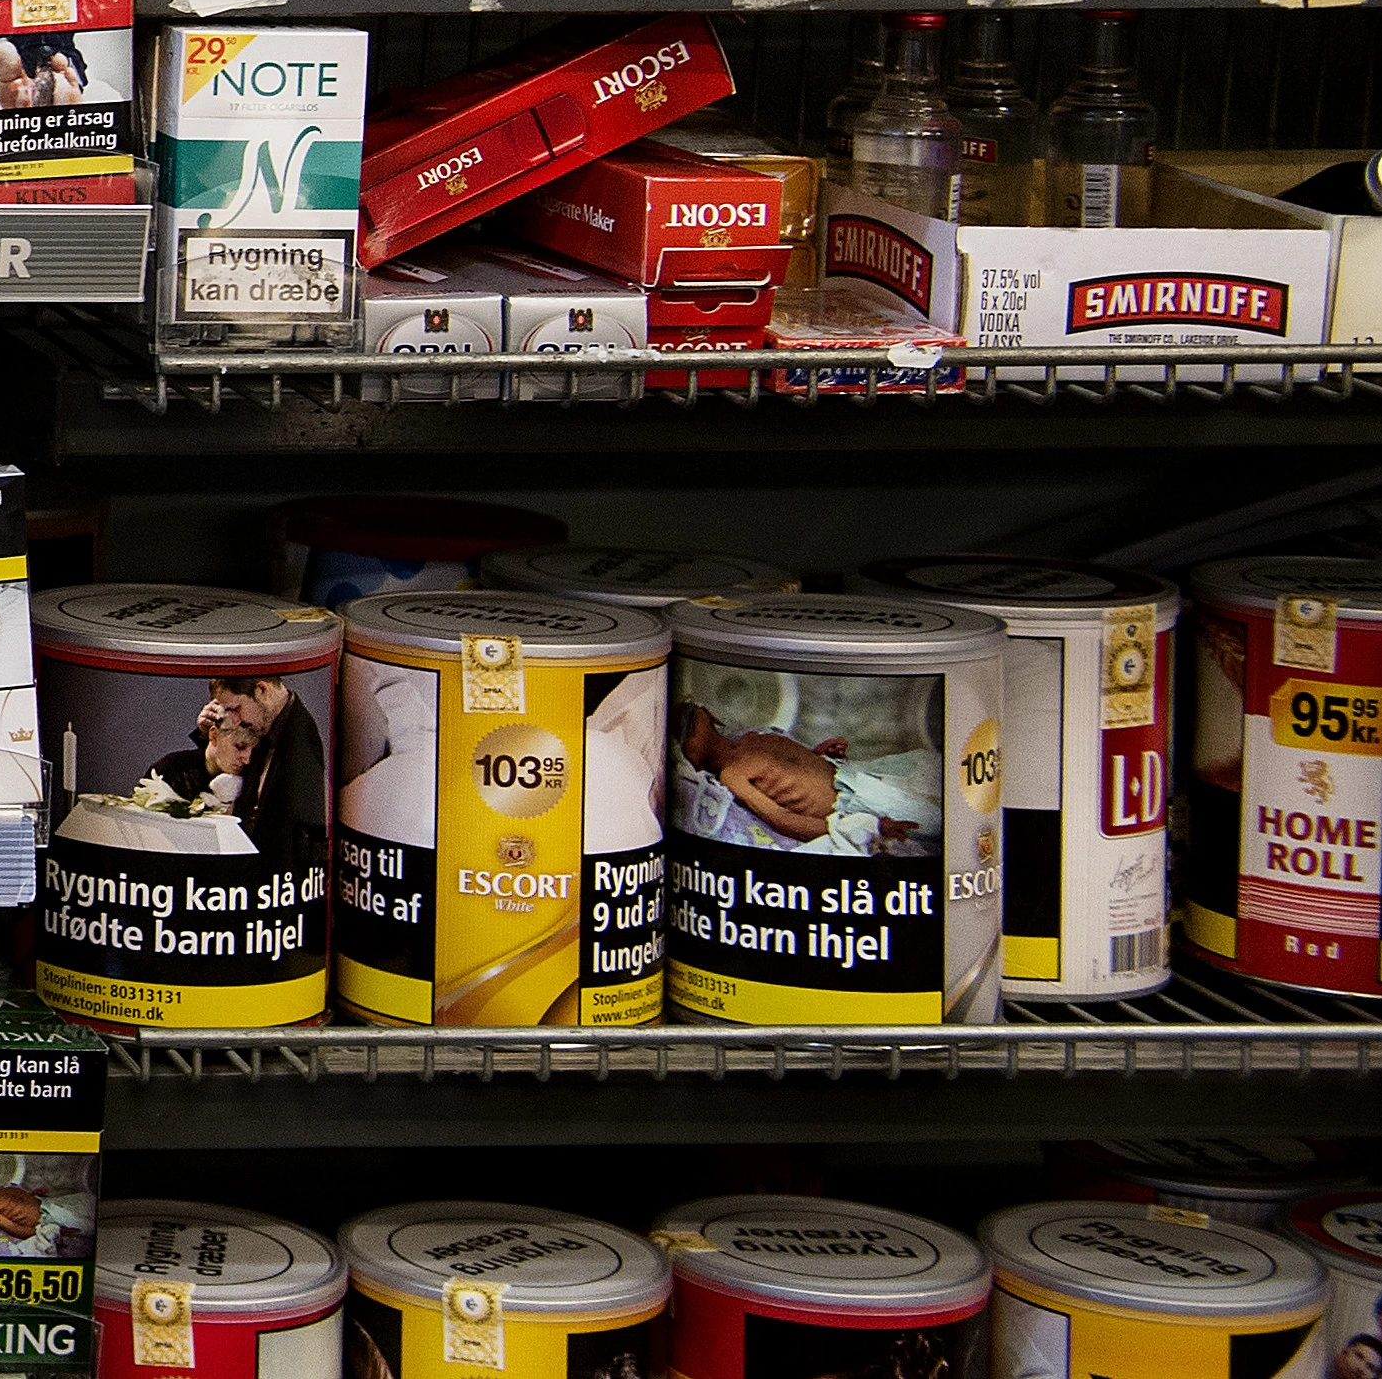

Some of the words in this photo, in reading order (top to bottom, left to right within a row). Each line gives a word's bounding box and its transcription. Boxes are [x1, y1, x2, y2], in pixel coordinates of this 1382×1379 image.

[213, 59, 338, 97] NOTE
[592, 40, 691, 105] ESCORT
[666, 204, 766, 226] ESCORT
[834, 223, 924, 298] SMIRNOFF
[982, 268, 1019, 290] 37.5%
[1023, 269, 1041, 289] vol
[981, 291, 988, 310] 6
[1002, 291, 1027, 311] 20cl
[1084, 282, 1268, 321] SMIRNOFF
[980, 313, 1020, 332] VODKA
[1291, 692, 1350, 742] 95
[1352, 698, 1379, 718] 95
[1351, 721, 1380, 743] kr.
[475, 752, 542, 789] 103
[543, 757, 564, 773] 95
[545, 777, 562, 788] KR
[1259, 807, 1376, 849] HOME
[1267, 842, 1365, 883] ROLL
[459, 871, 571, 899] ESCORT
